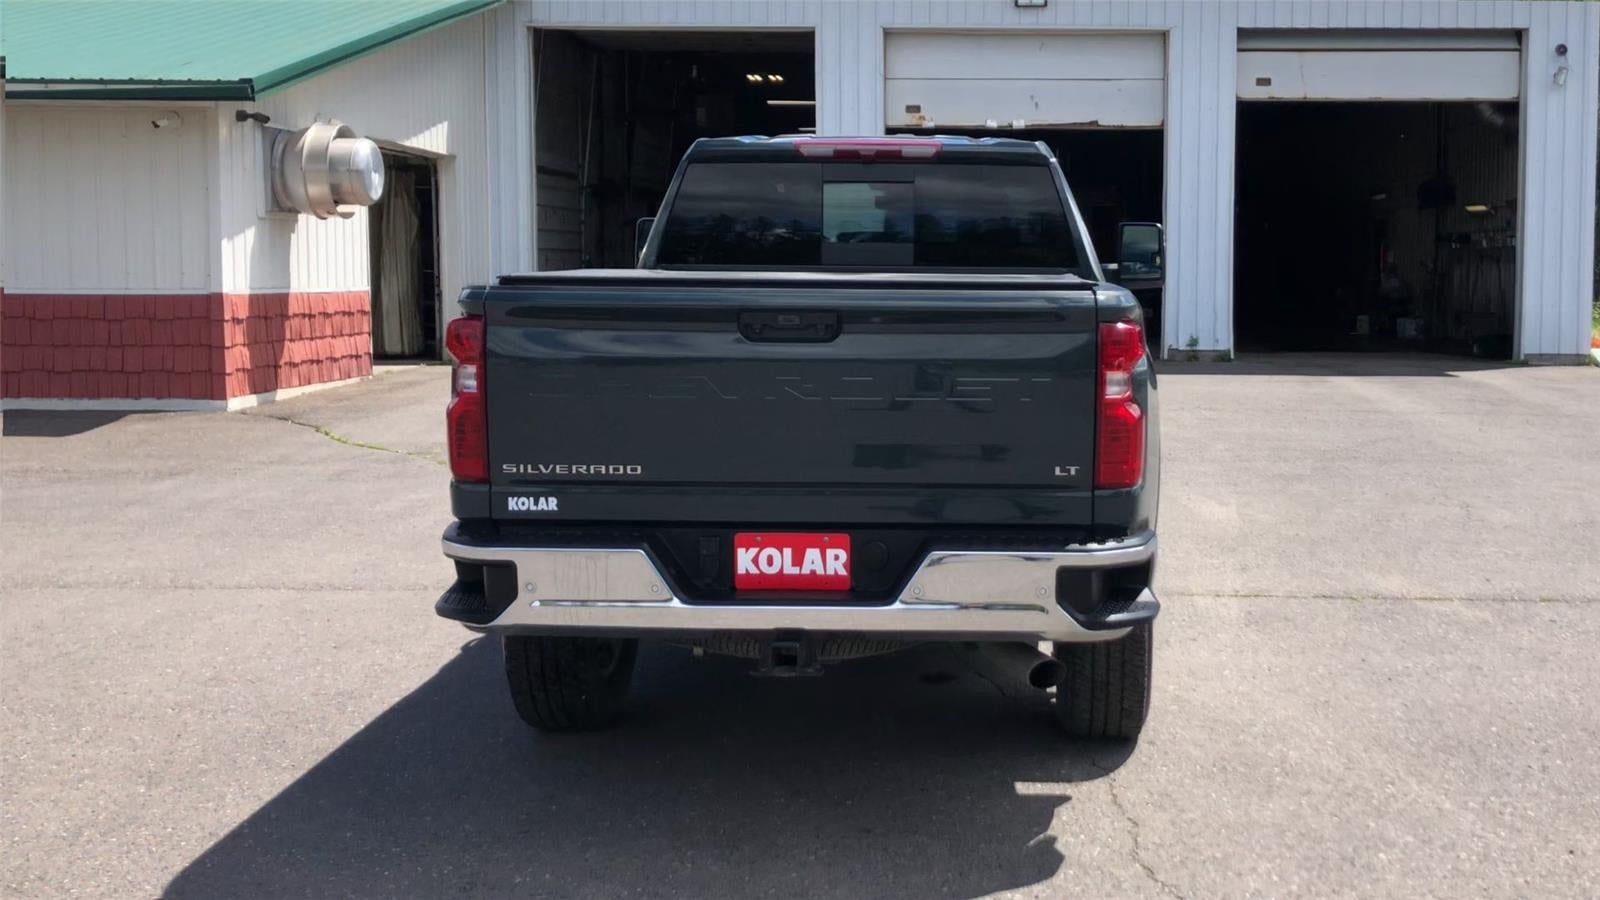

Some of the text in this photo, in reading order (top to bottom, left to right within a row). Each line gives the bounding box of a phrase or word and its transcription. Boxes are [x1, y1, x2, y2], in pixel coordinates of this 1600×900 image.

[502, 463, 643, 475] SILVERADO
[1055, 466, 1080, 476] LT
[507, 496, 559, 511] KOLAR
[736, 547, 848, 576] KOLAR
